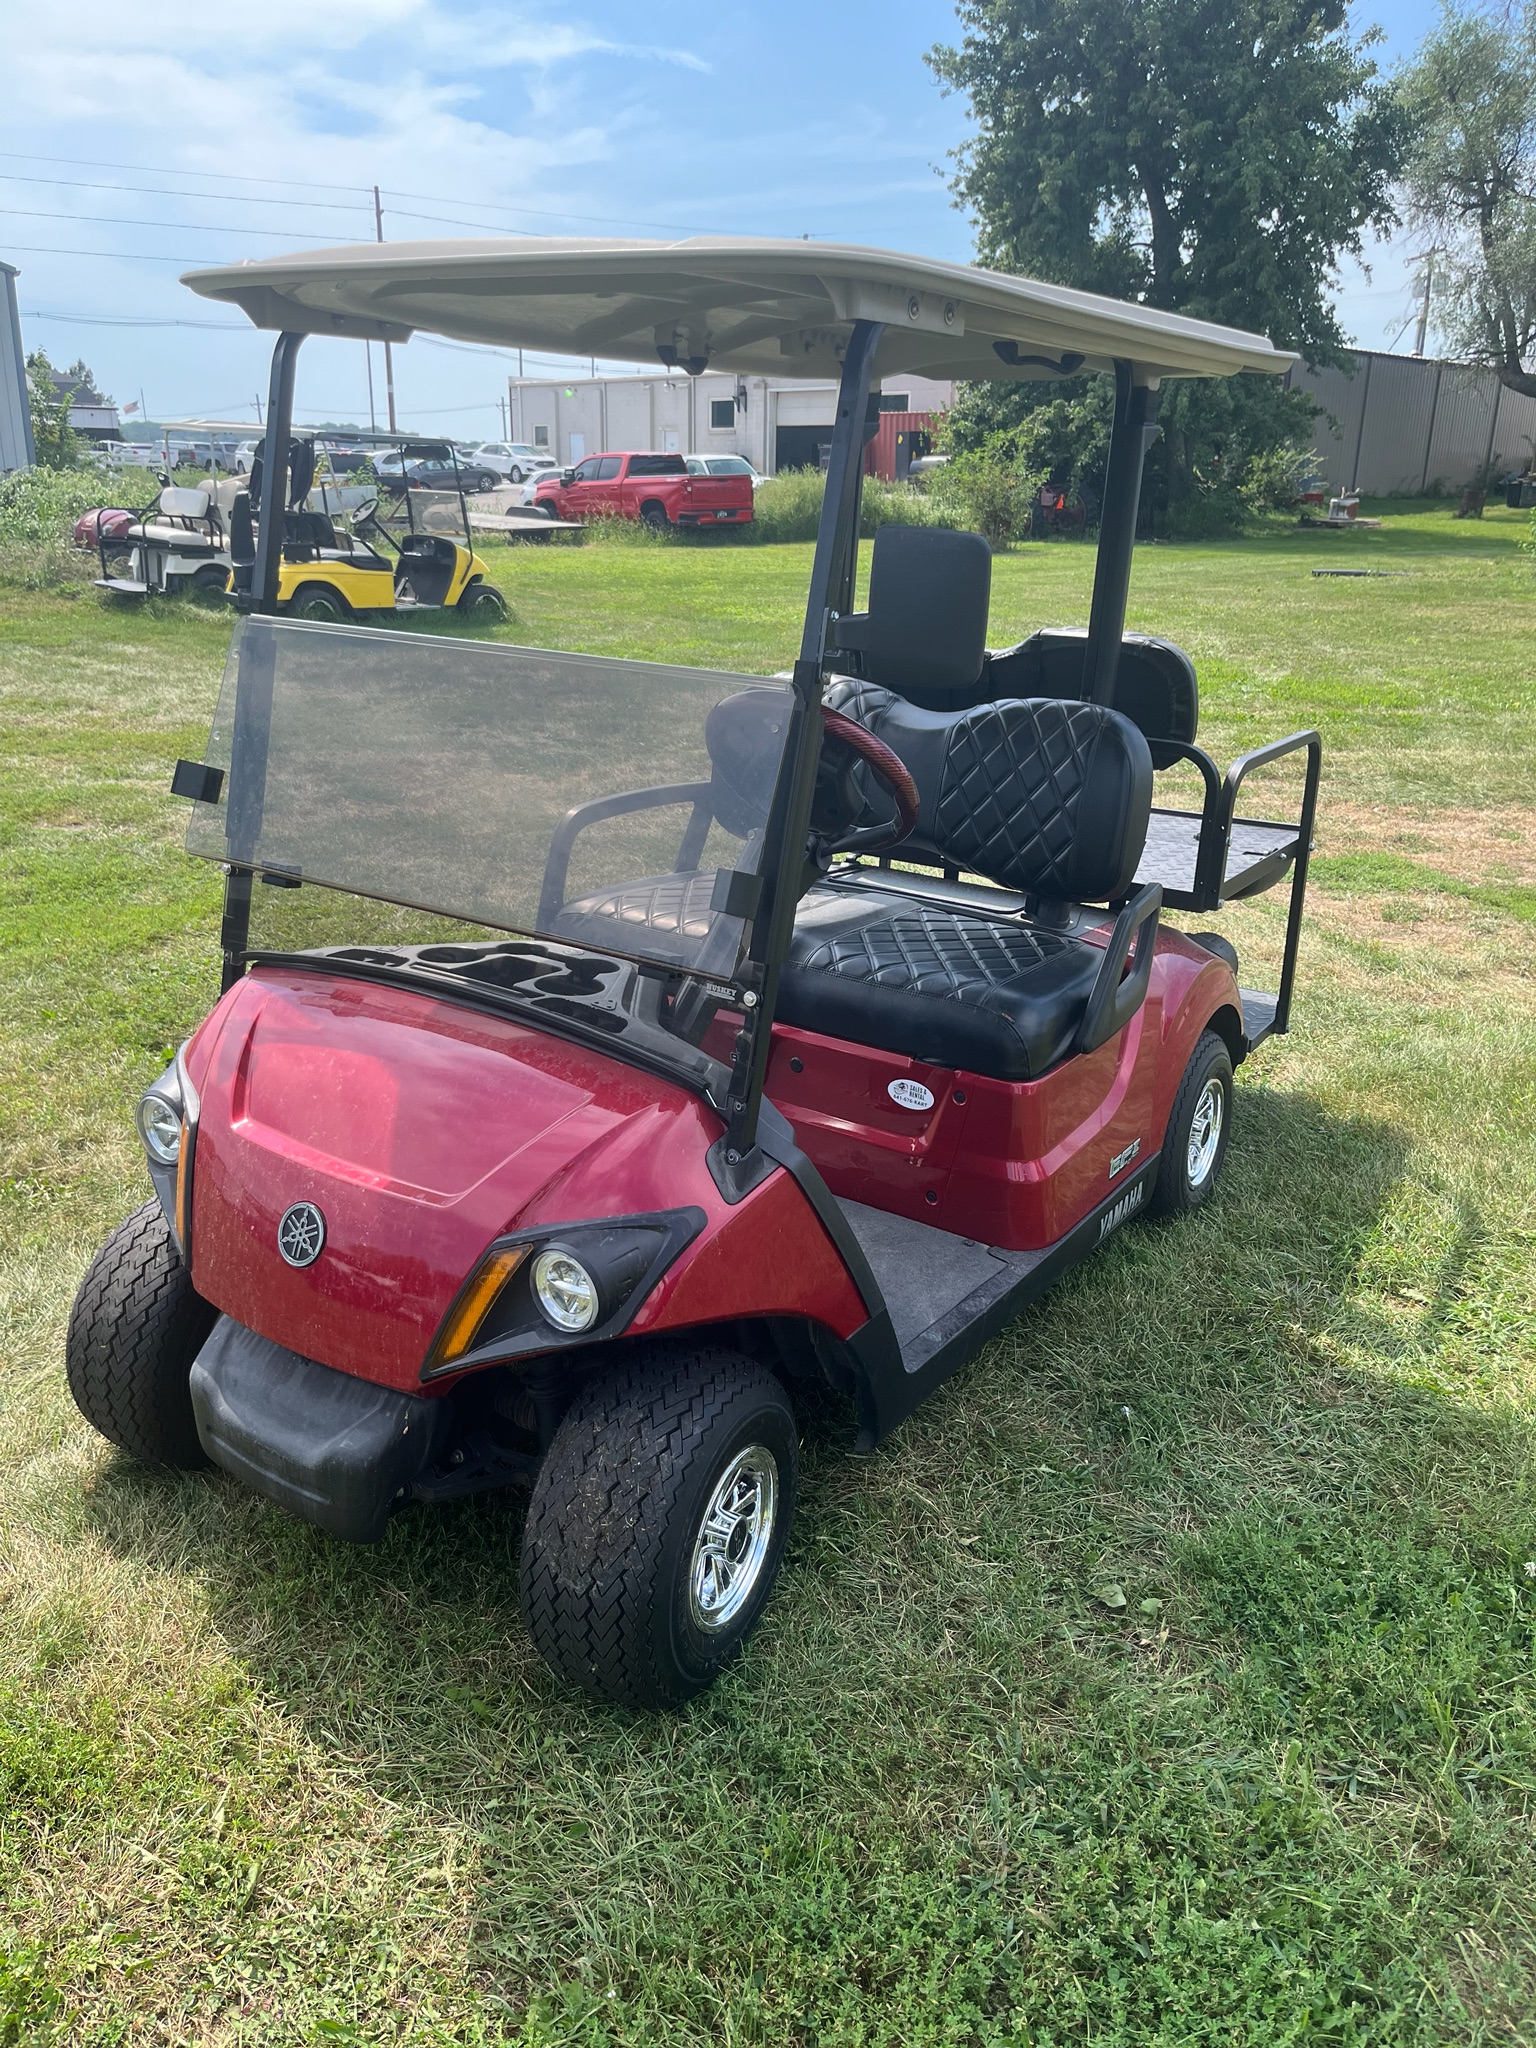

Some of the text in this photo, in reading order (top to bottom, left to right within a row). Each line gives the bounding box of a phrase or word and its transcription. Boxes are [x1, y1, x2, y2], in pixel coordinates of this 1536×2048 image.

[706, 983, 737, 996] HUSKEY
[910, 1085, 923, 1094] SALES
[909, 1091, 925, 1101] RENTAL
[1099, 1181, 1143, 1241] YAMAHA
